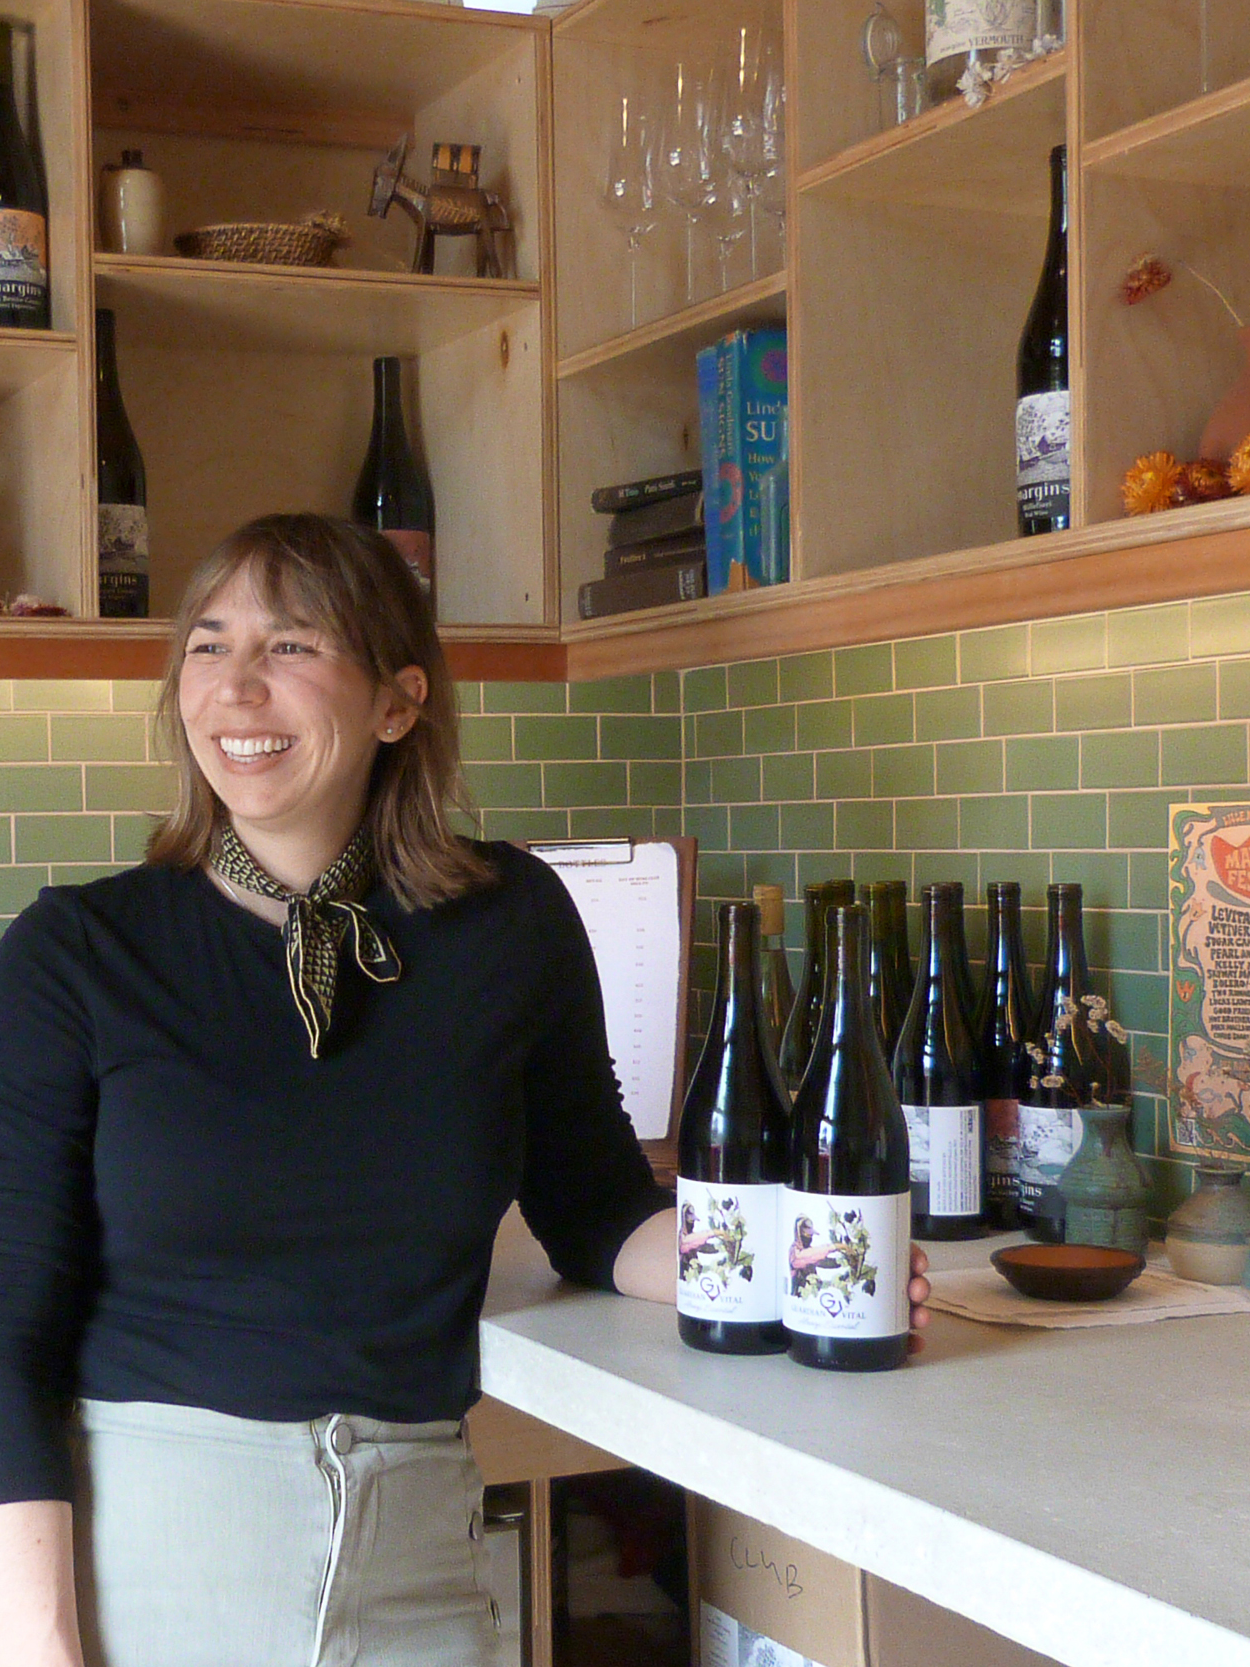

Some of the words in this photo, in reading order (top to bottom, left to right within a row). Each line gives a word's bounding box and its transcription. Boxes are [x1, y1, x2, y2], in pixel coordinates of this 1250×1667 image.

[969, 35, 1024, 46] VERMOUTH
[748, 452, 775, 464] How
[720, 1296, 742, 1304] VITAL
[791, 1304, 826, 1317] GUARDIAN
